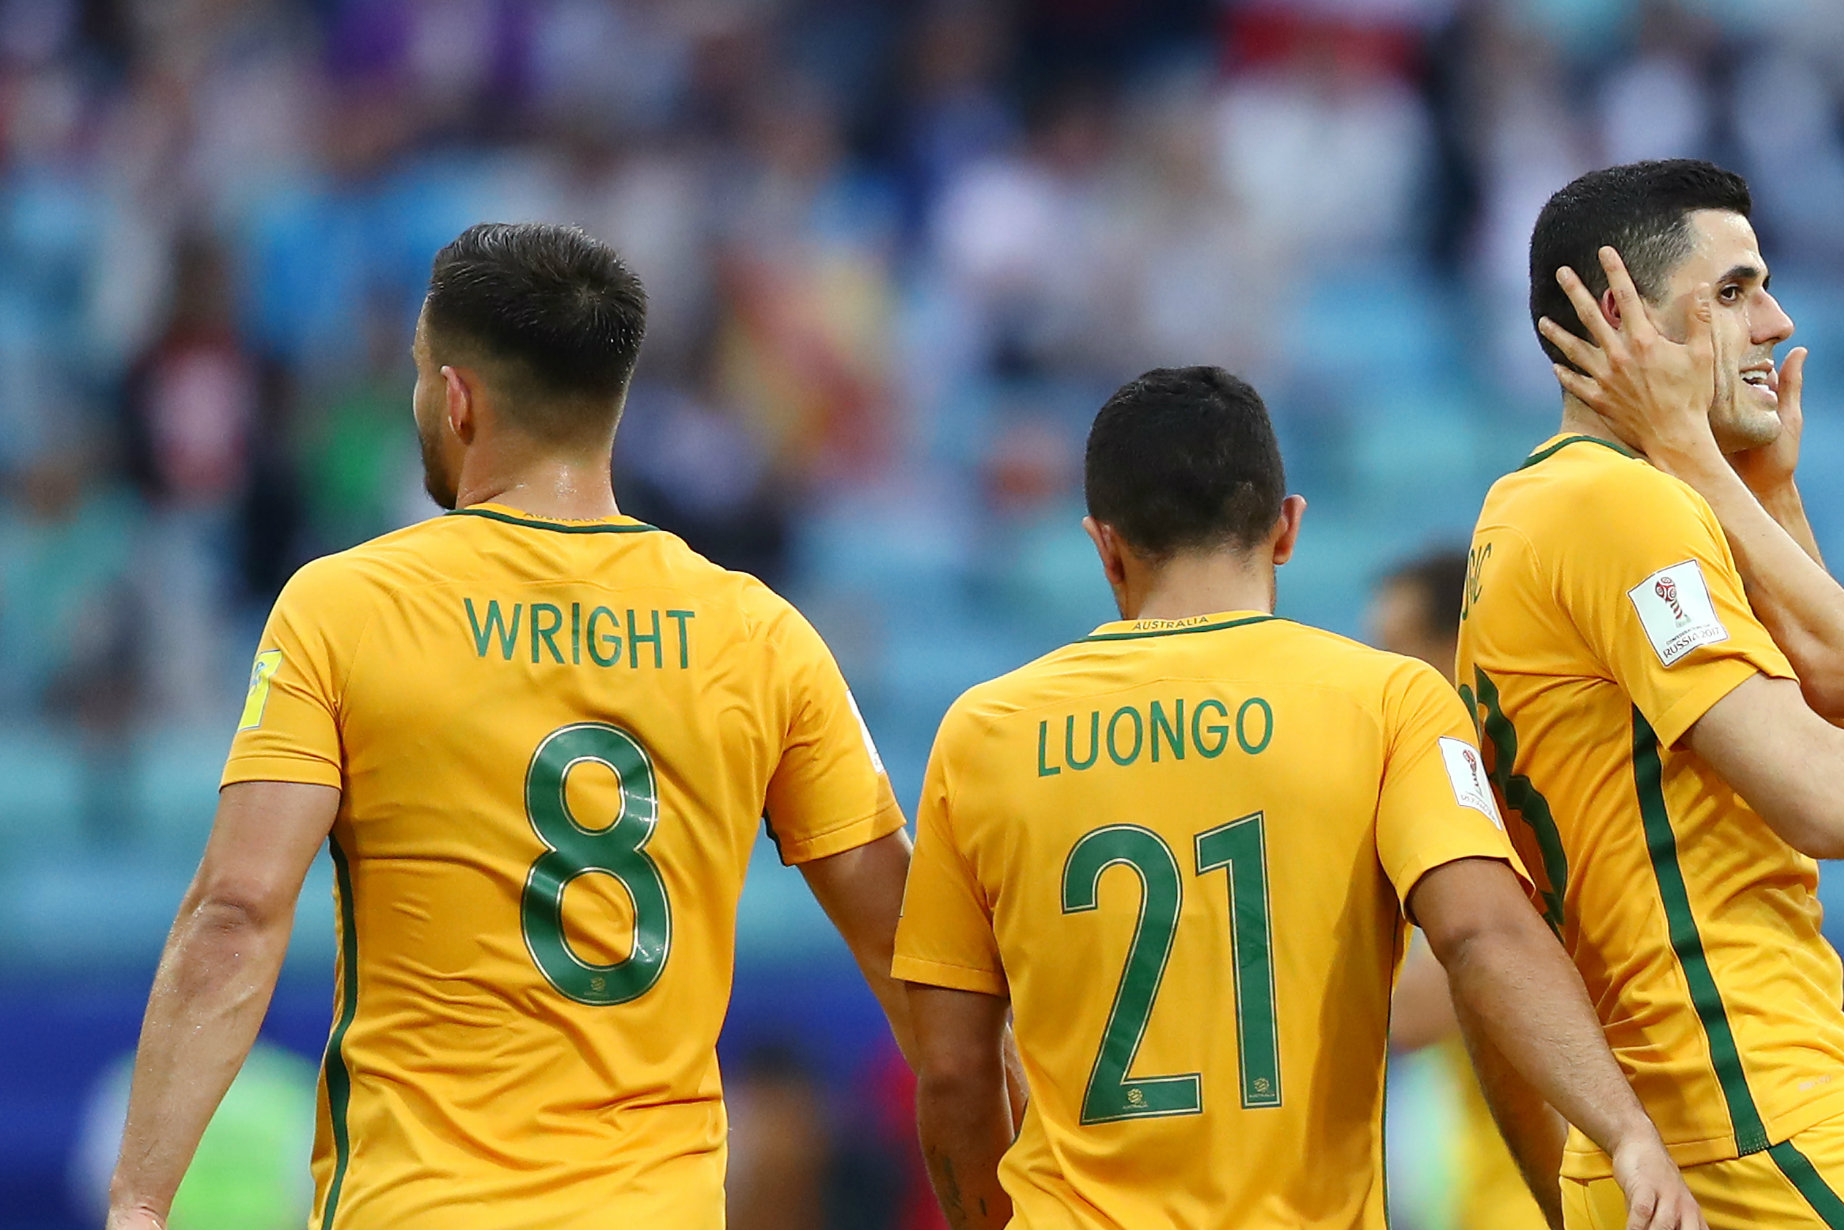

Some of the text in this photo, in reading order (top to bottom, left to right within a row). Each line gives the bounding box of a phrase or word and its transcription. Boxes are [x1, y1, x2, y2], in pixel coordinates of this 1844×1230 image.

[463, 597, 696, 669] WRIGHT
[1131, 616, 1209, 632] AUSTRALIA
[1662, 626, 1720, 659] RUSSIA 2017
[1038, 696, 1274, 778] LUONGO
[521, 721, 673, 1007] 8
[1060, 809, 1283, 1126] 21
